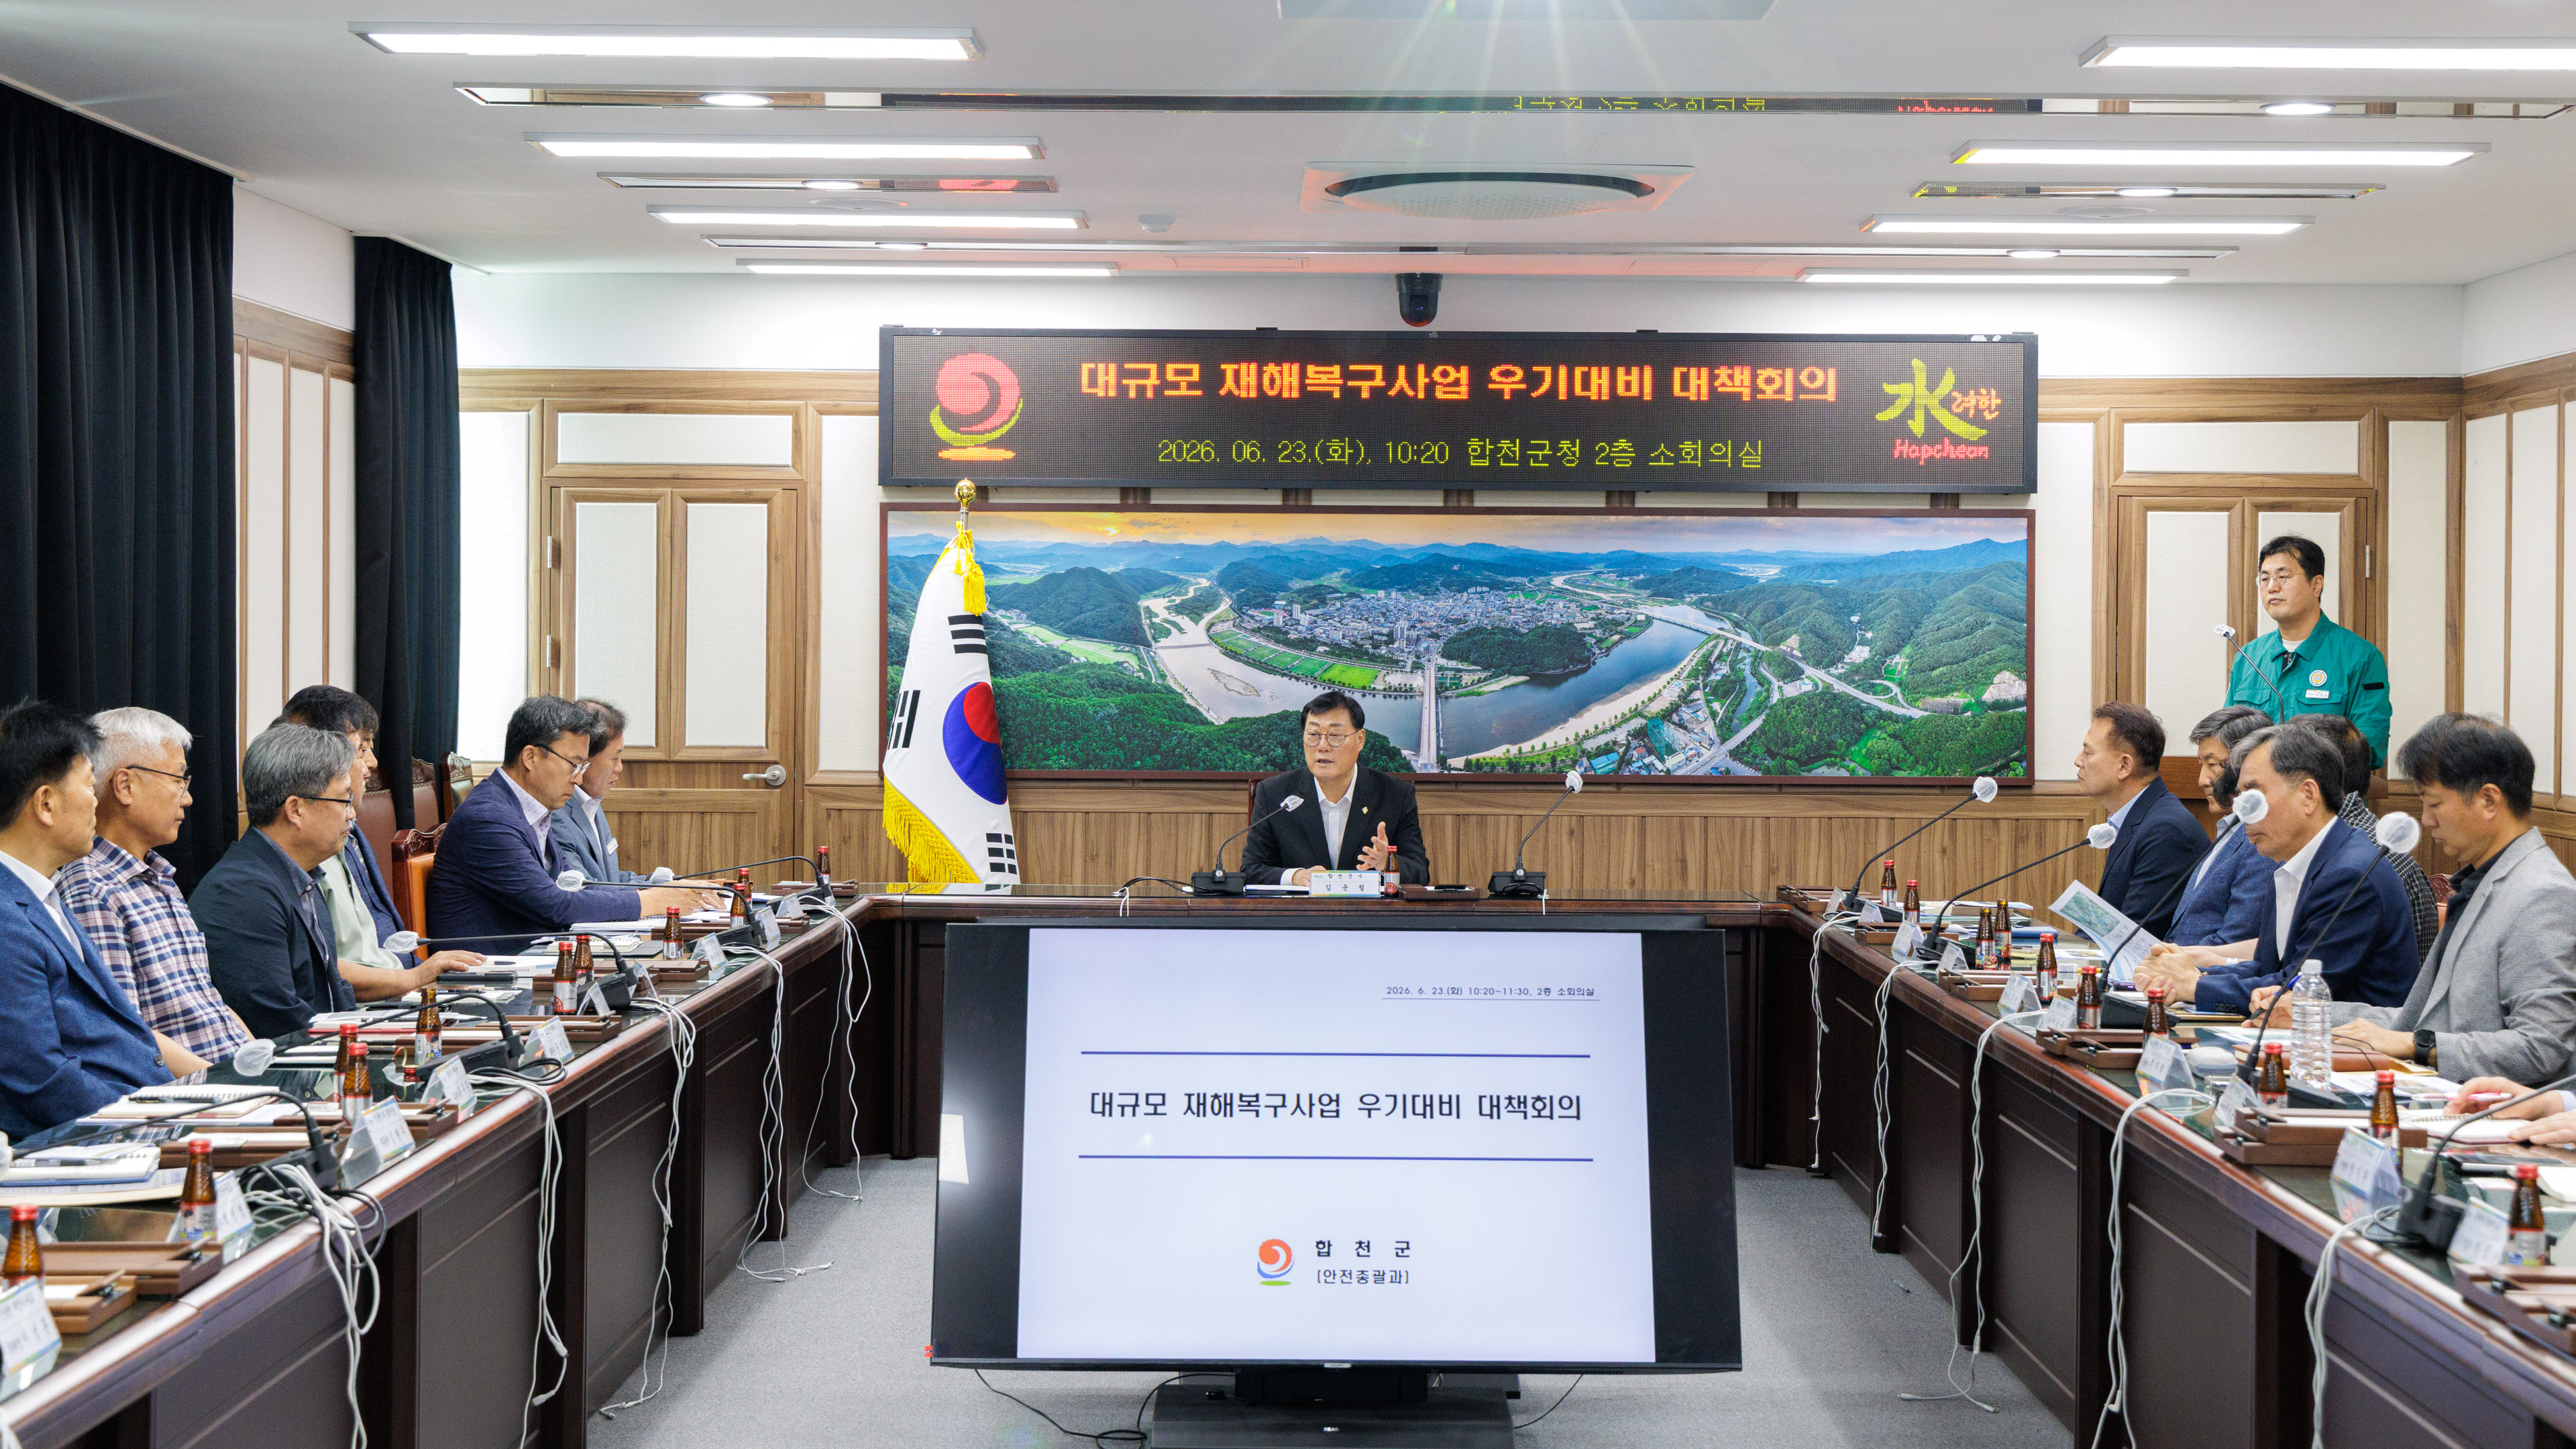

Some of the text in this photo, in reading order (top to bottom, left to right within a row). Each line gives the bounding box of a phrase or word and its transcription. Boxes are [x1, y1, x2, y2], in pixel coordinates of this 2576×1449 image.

[1081, 361, 1837, 402] 대규모 재해복구사업 우기대비 대책회의
[1158, 437, 1763, 468] 2026. 06. 23.(화), 10:20 합천군청 2층 소회의실
[1386, 986, 1595, 997] 2026. 6. 23.(화) 10:20~11:30, 2층 소회의실
[1090, 1091, 1581, 1121] 대규모 재해복구사업 우기대비 대책회의
